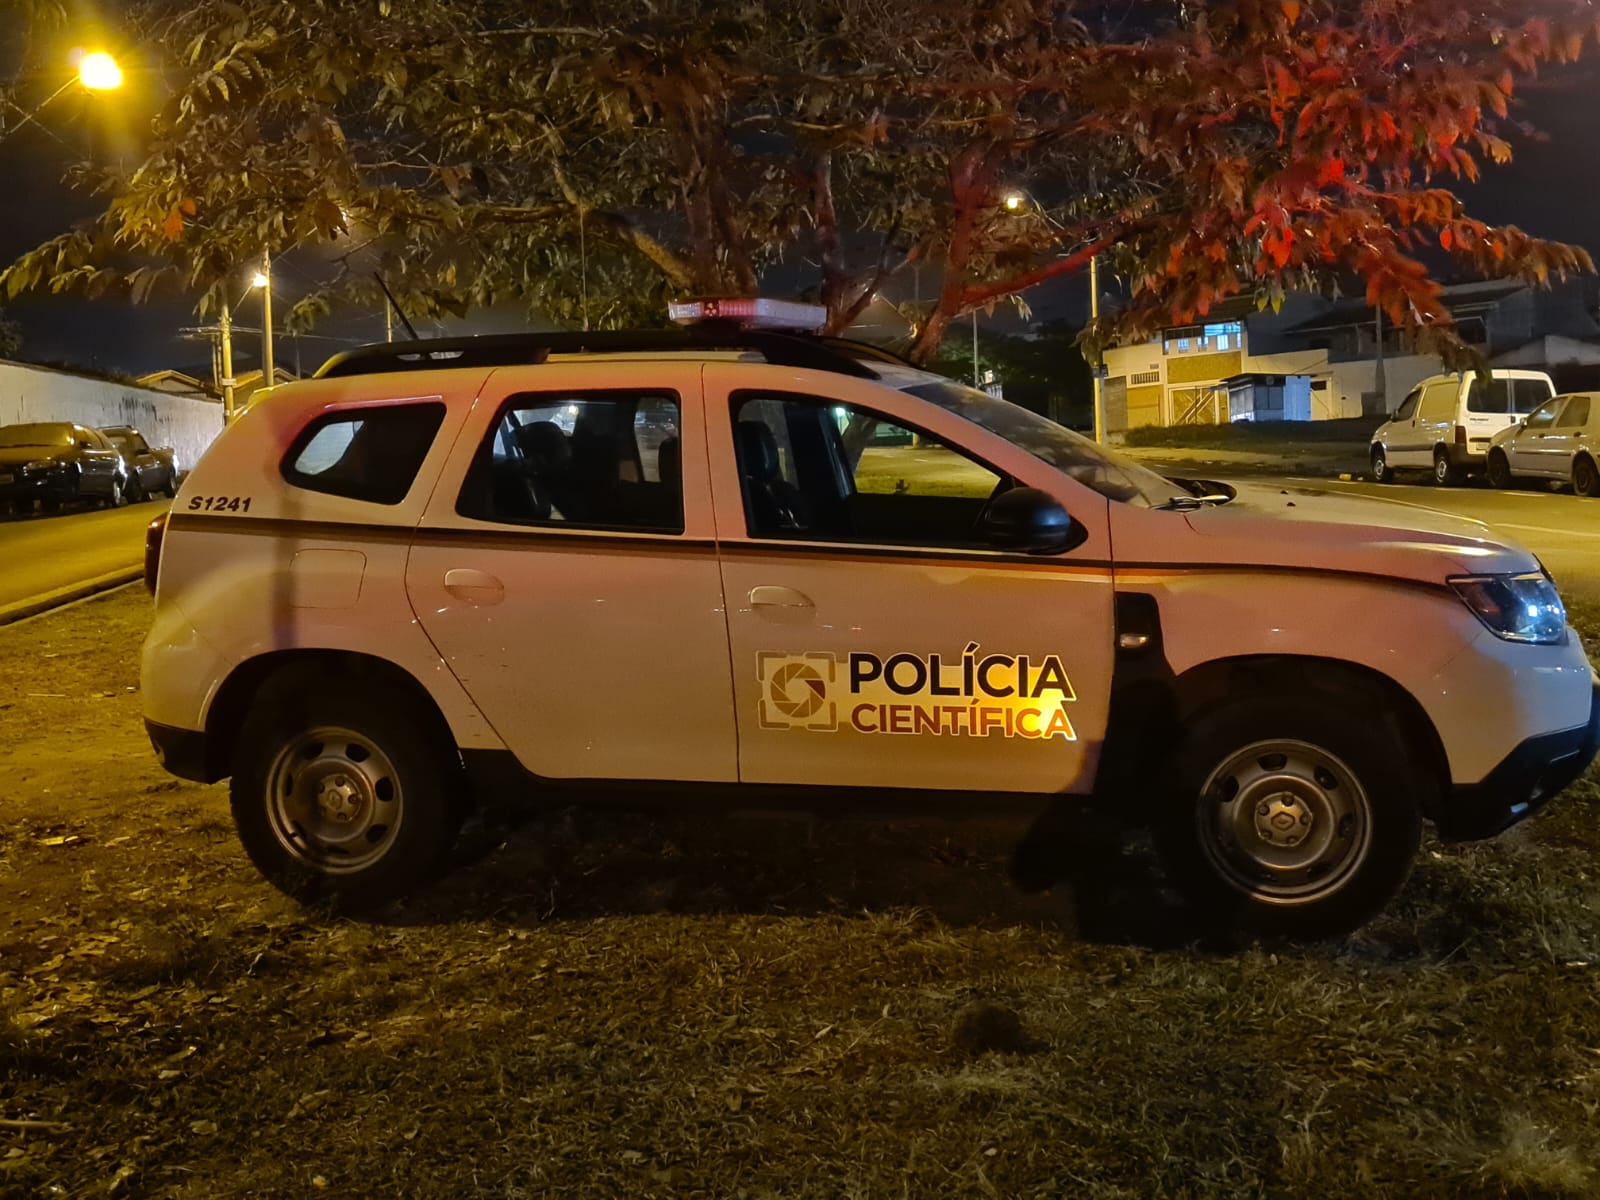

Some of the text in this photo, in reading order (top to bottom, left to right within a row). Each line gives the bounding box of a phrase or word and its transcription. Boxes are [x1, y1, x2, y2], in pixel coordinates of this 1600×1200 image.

[188, 496, 251, 512] S1241
[850, 642, 1075, 700] POLÍCIA
[851, 698, 1076, 739] CIENTÍFICA
